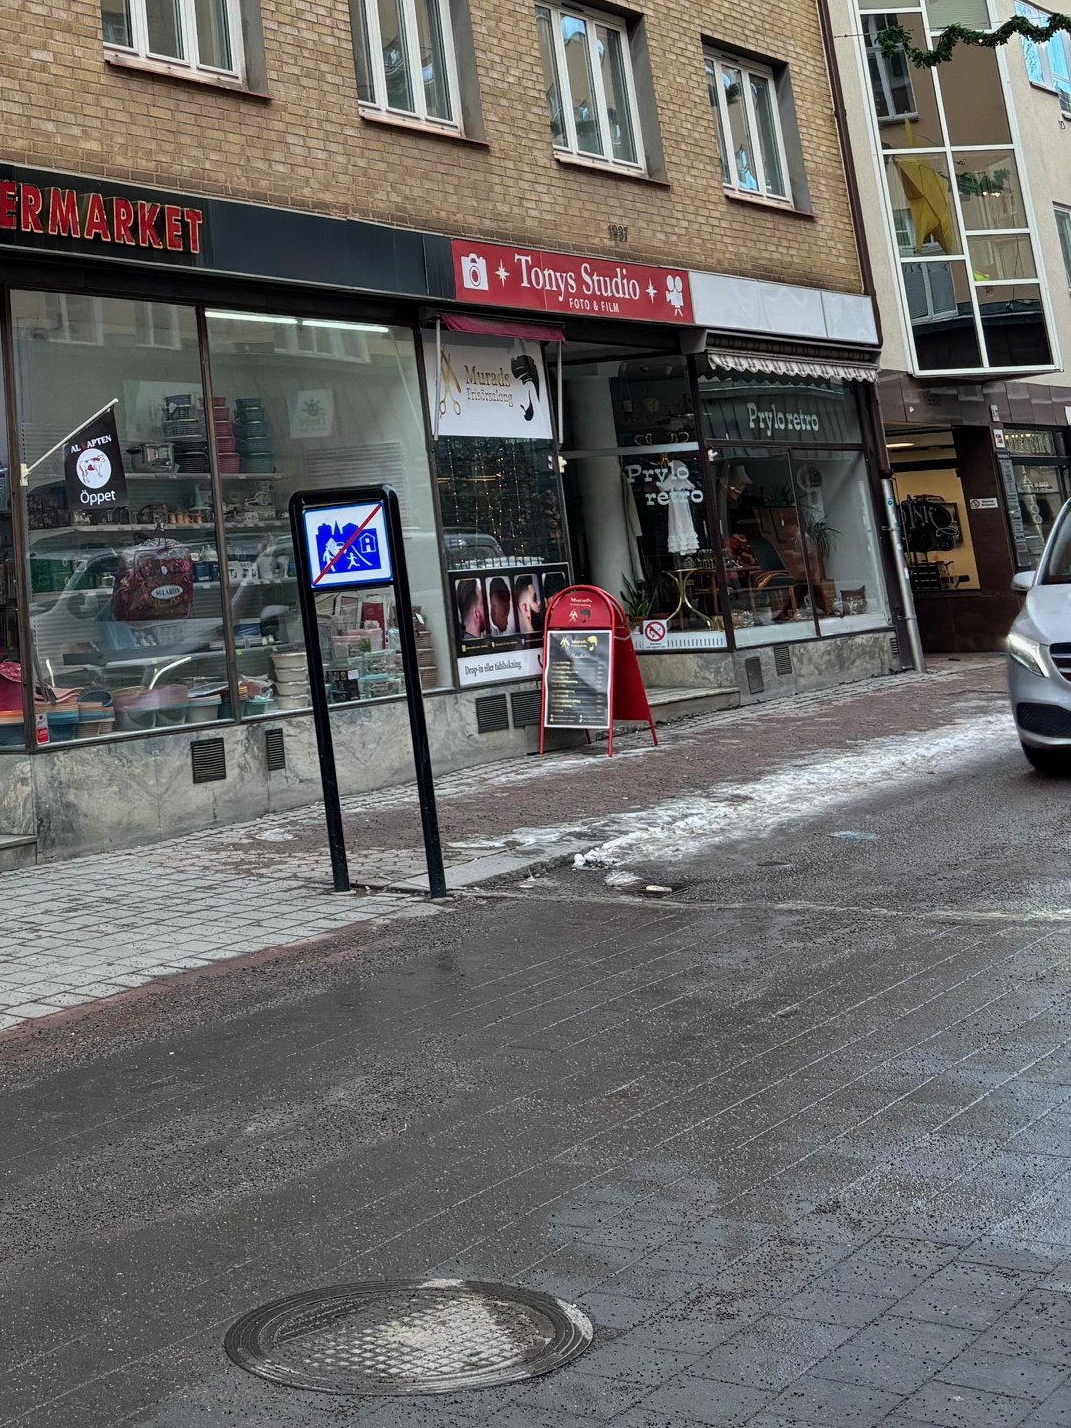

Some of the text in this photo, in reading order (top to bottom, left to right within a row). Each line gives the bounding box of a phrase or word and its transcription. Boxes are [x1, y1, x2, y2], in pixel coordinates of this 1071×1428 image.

[514, 252, 640, 302] Tonys Studio
[569, 297, 620, 313] FOTO & FILM
[464, 365, 511, 387] Murads
[466, 387, 514, 407] Frisörsalong
[786, 409, 819, 431] retro
[624, 462, 689, 487] Prylo
[80, 489, 116, 506] Öppet
